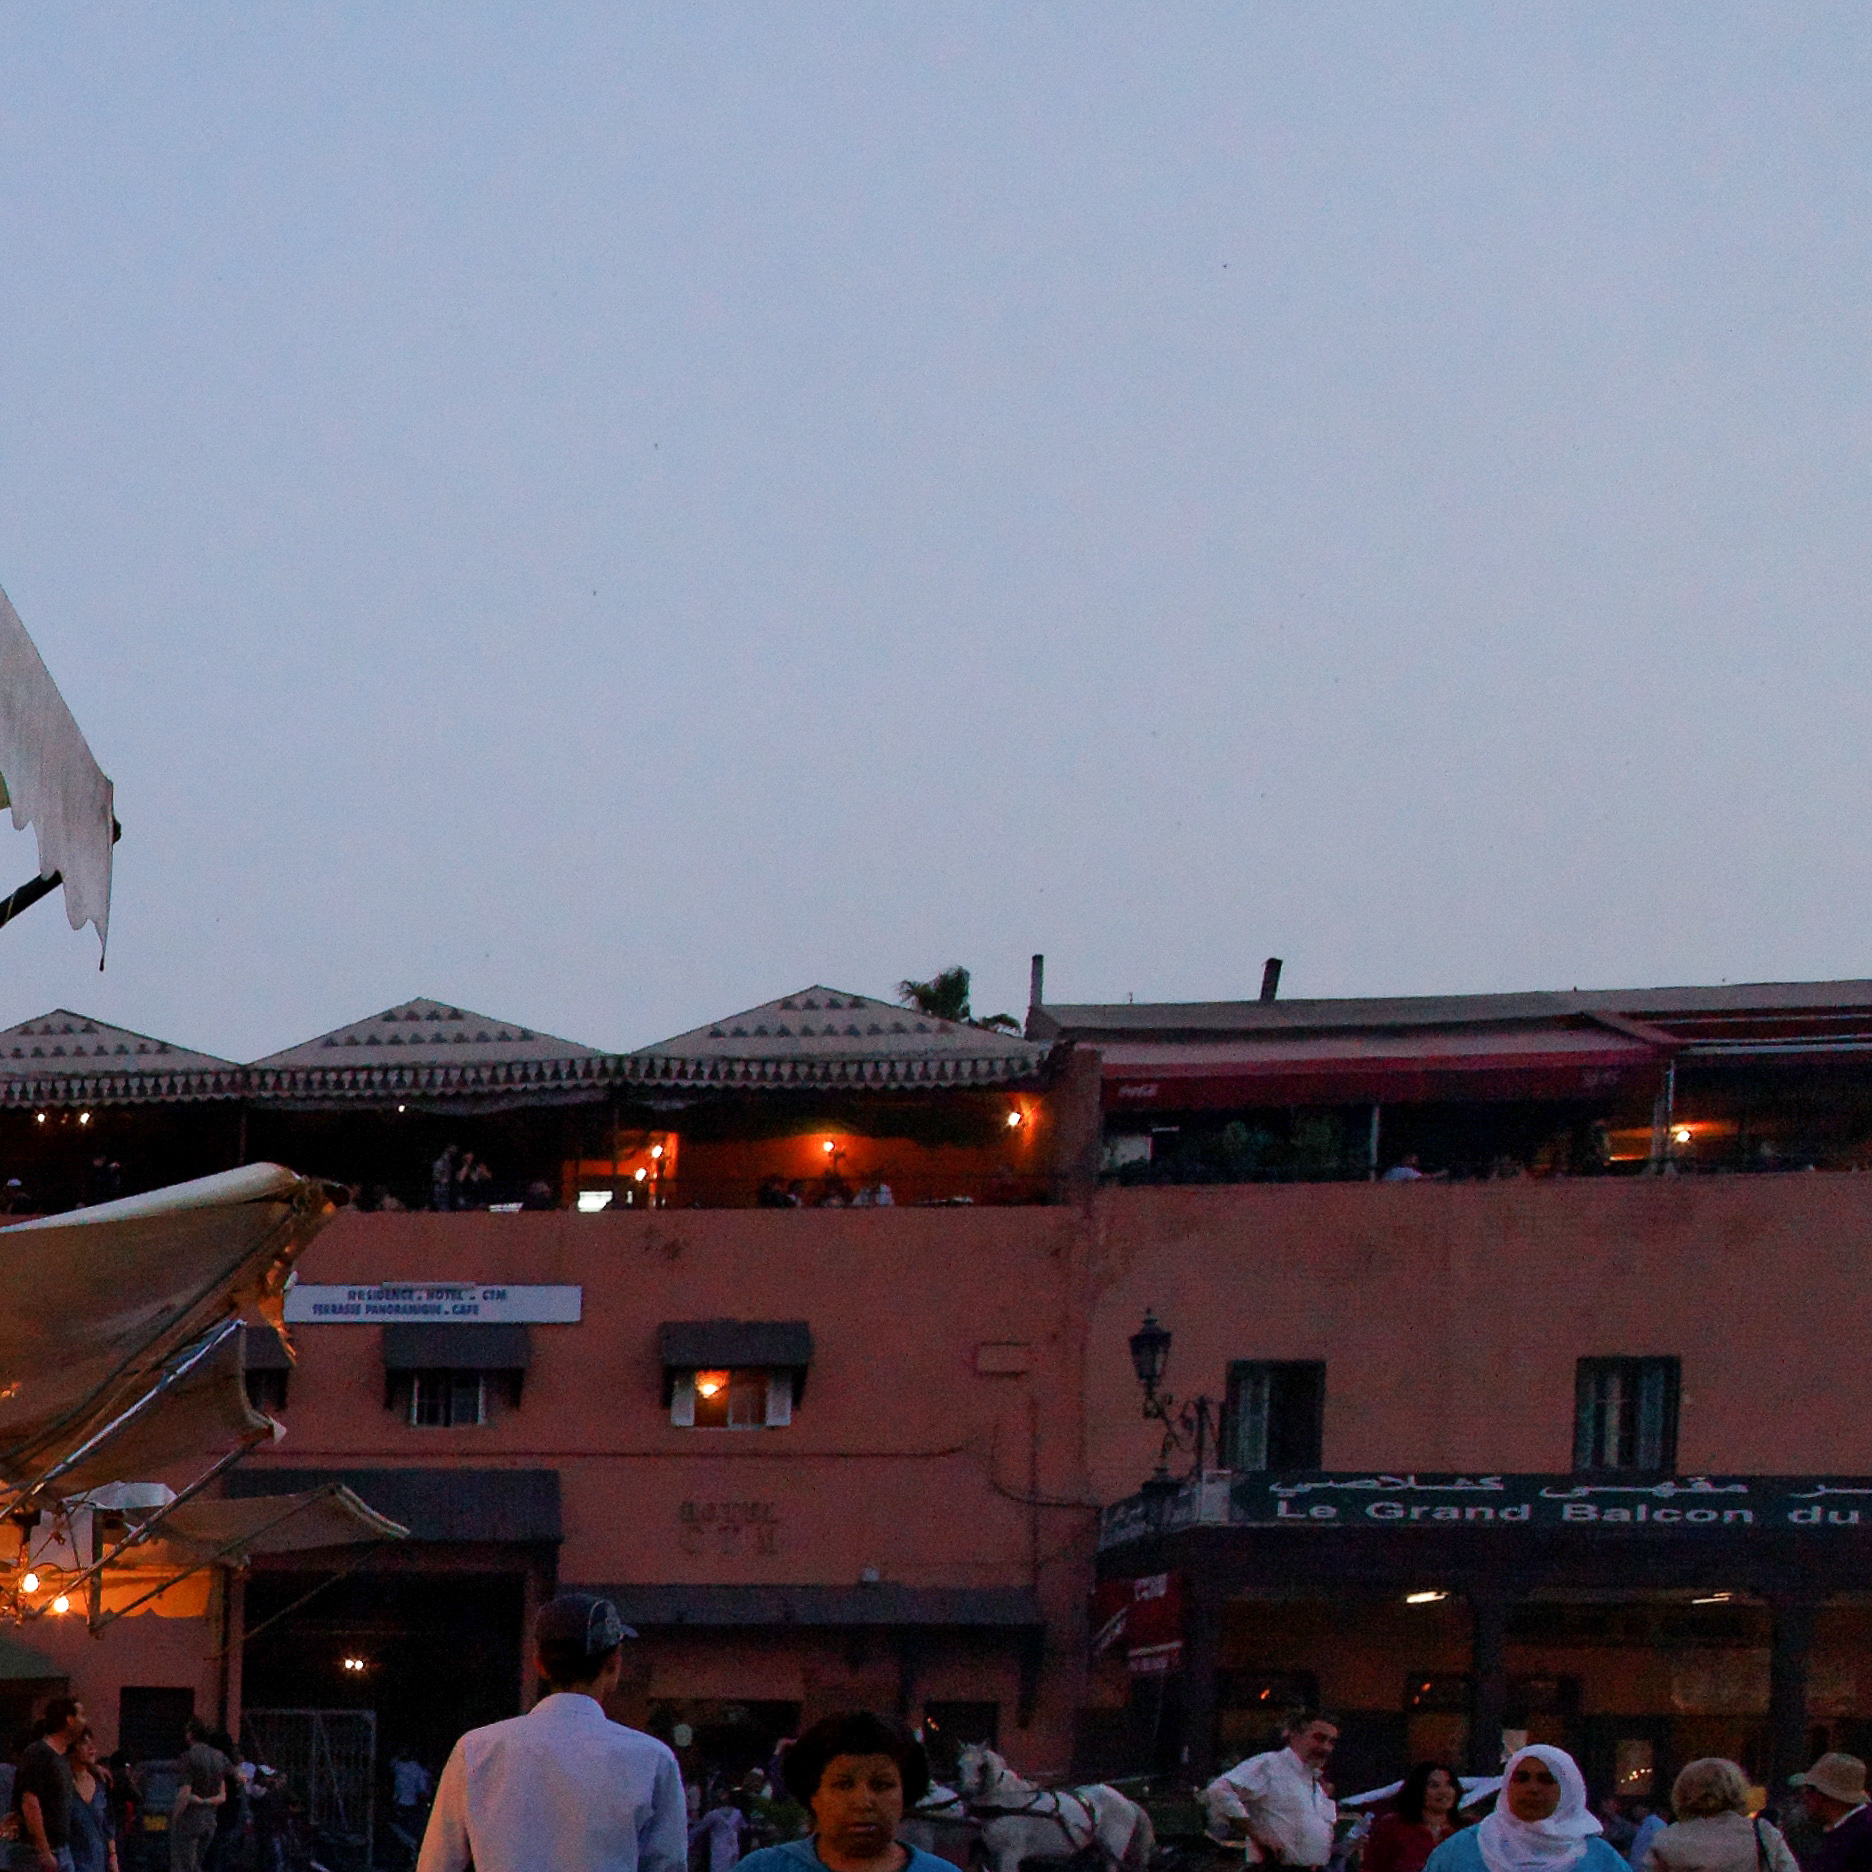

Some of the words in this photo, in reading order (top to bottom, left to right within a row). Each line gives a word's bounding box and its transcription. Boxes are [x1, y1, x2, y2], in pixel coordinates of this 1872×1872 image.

[1277, 1500, 1338, 1519] Le
[1366, 1502, 1531, 1522] Grand
[1562, 1502, 1754, 1524] Balcon
[1788, 1505, 1860, 1525] du
